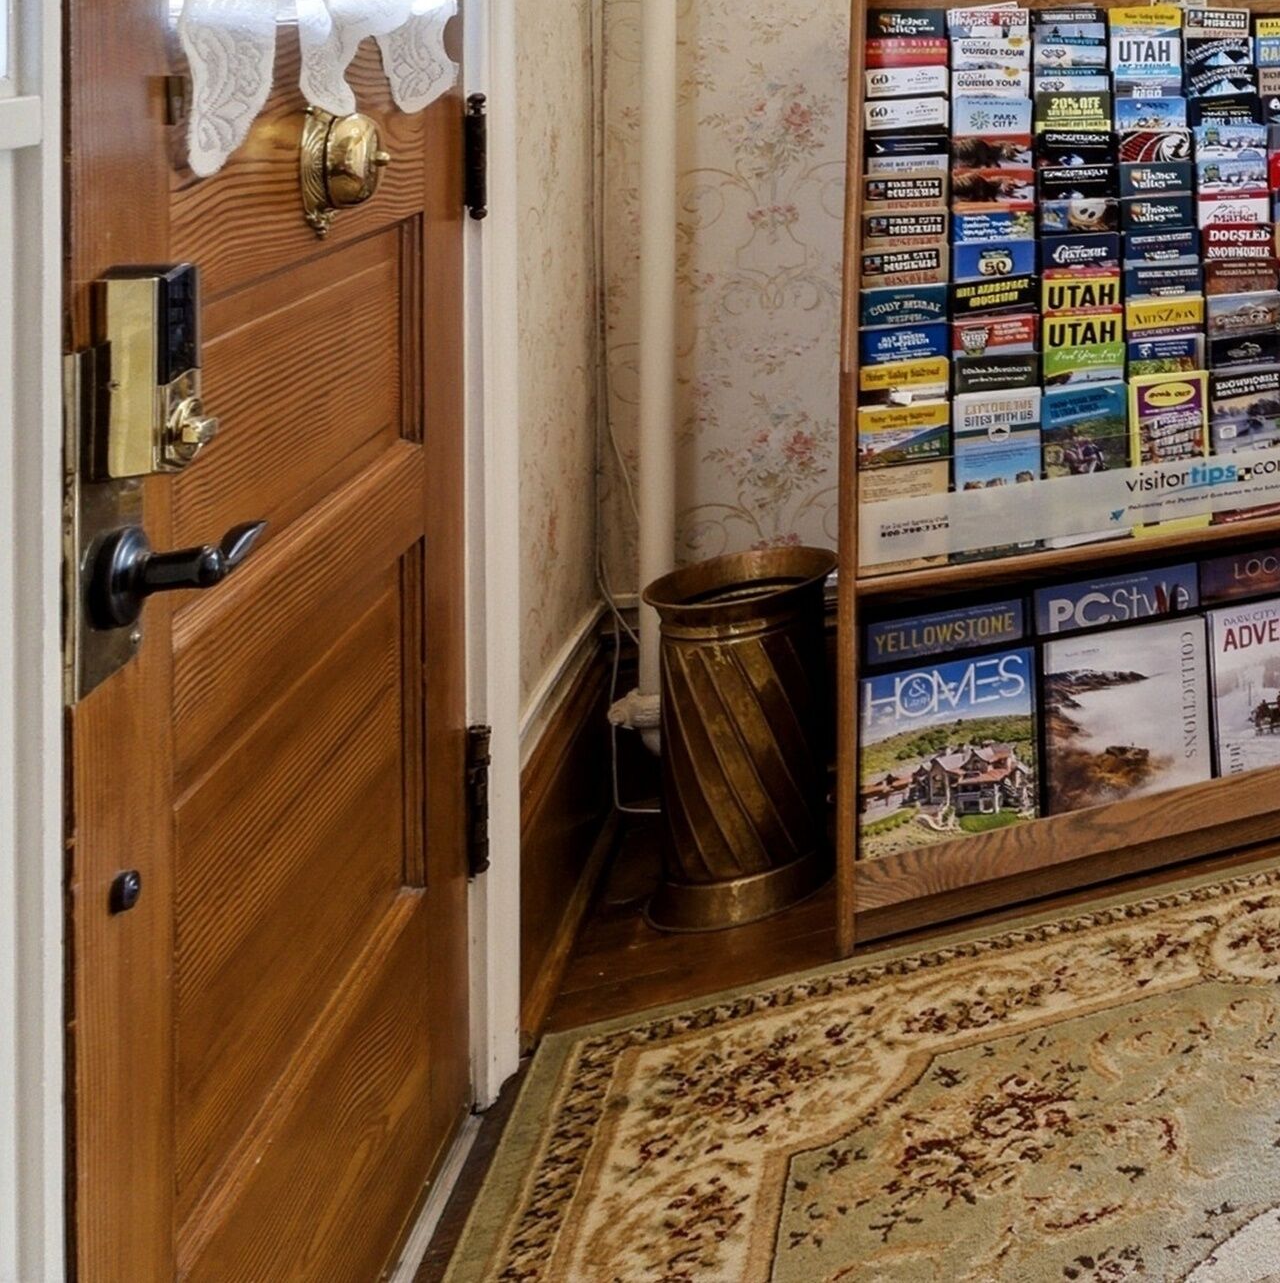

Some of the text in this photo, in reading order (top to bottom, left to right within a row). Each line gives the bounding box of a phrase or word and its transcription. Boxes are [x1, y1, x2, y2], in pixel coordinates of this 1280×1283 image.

[1119, 40, 1171, 62] UTAH
[1209, 230, 1270, 241] DOGSLED
[1048, 283, 1115, 309] UTAH
[1049, 320, 1116, 347] UTAH
[964, 409, 1034, 427] SITES WITH US
[874, 612, 1015, 655] YELLOWSTONE
[864, 654, 1025, 726] HOMES
[1180, 631, 1199, 760] COLLECTIONS
